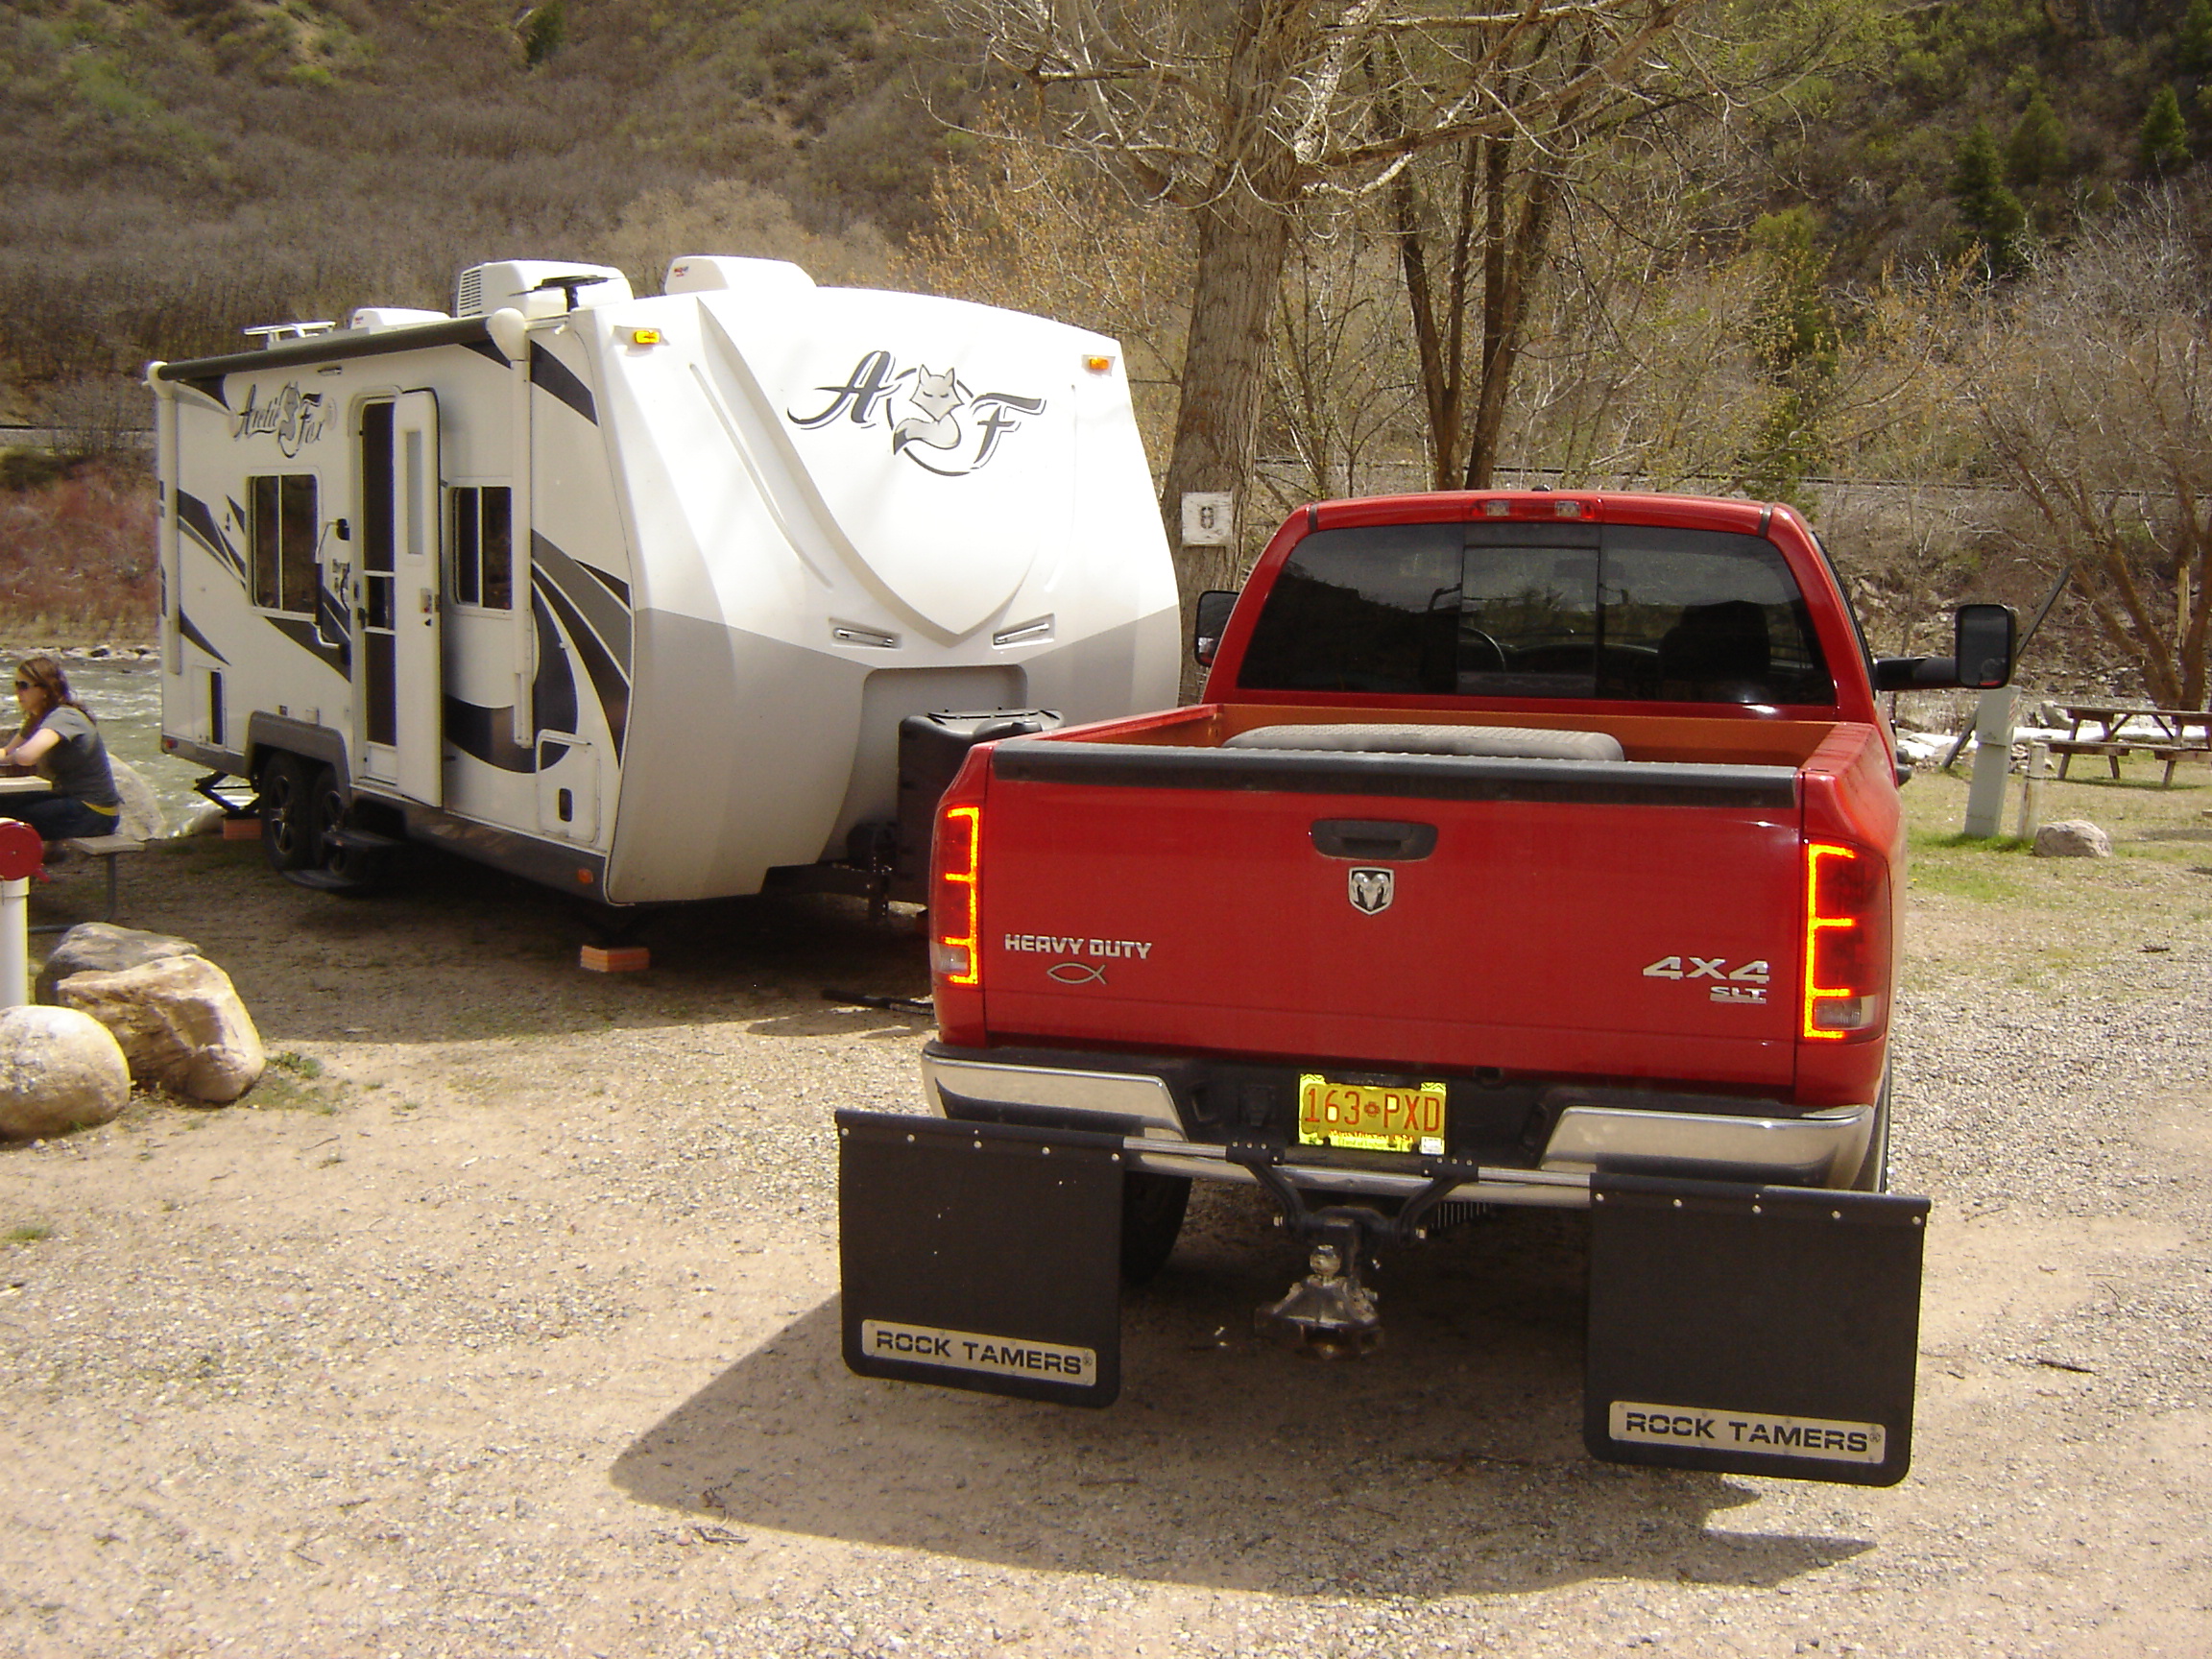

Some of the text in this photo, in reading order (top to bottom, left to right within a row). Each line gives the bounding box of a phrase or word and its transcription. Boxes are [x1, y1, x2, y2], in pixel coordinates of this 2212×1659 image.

[298, 392, 325, 446] Fox
[1200, 506, 1214, 529] 8
[1004, 933, 1152, 959] HEAVY DUTY
[1710, 985, 1767, 1004] SLT
[1305, 1088, 1440, 1132] 163 PXD
[876, 1330, 1082, 1375] ROCK TAMERS
[1625, 1411, 1868, 1453] ROCK TAMERS
